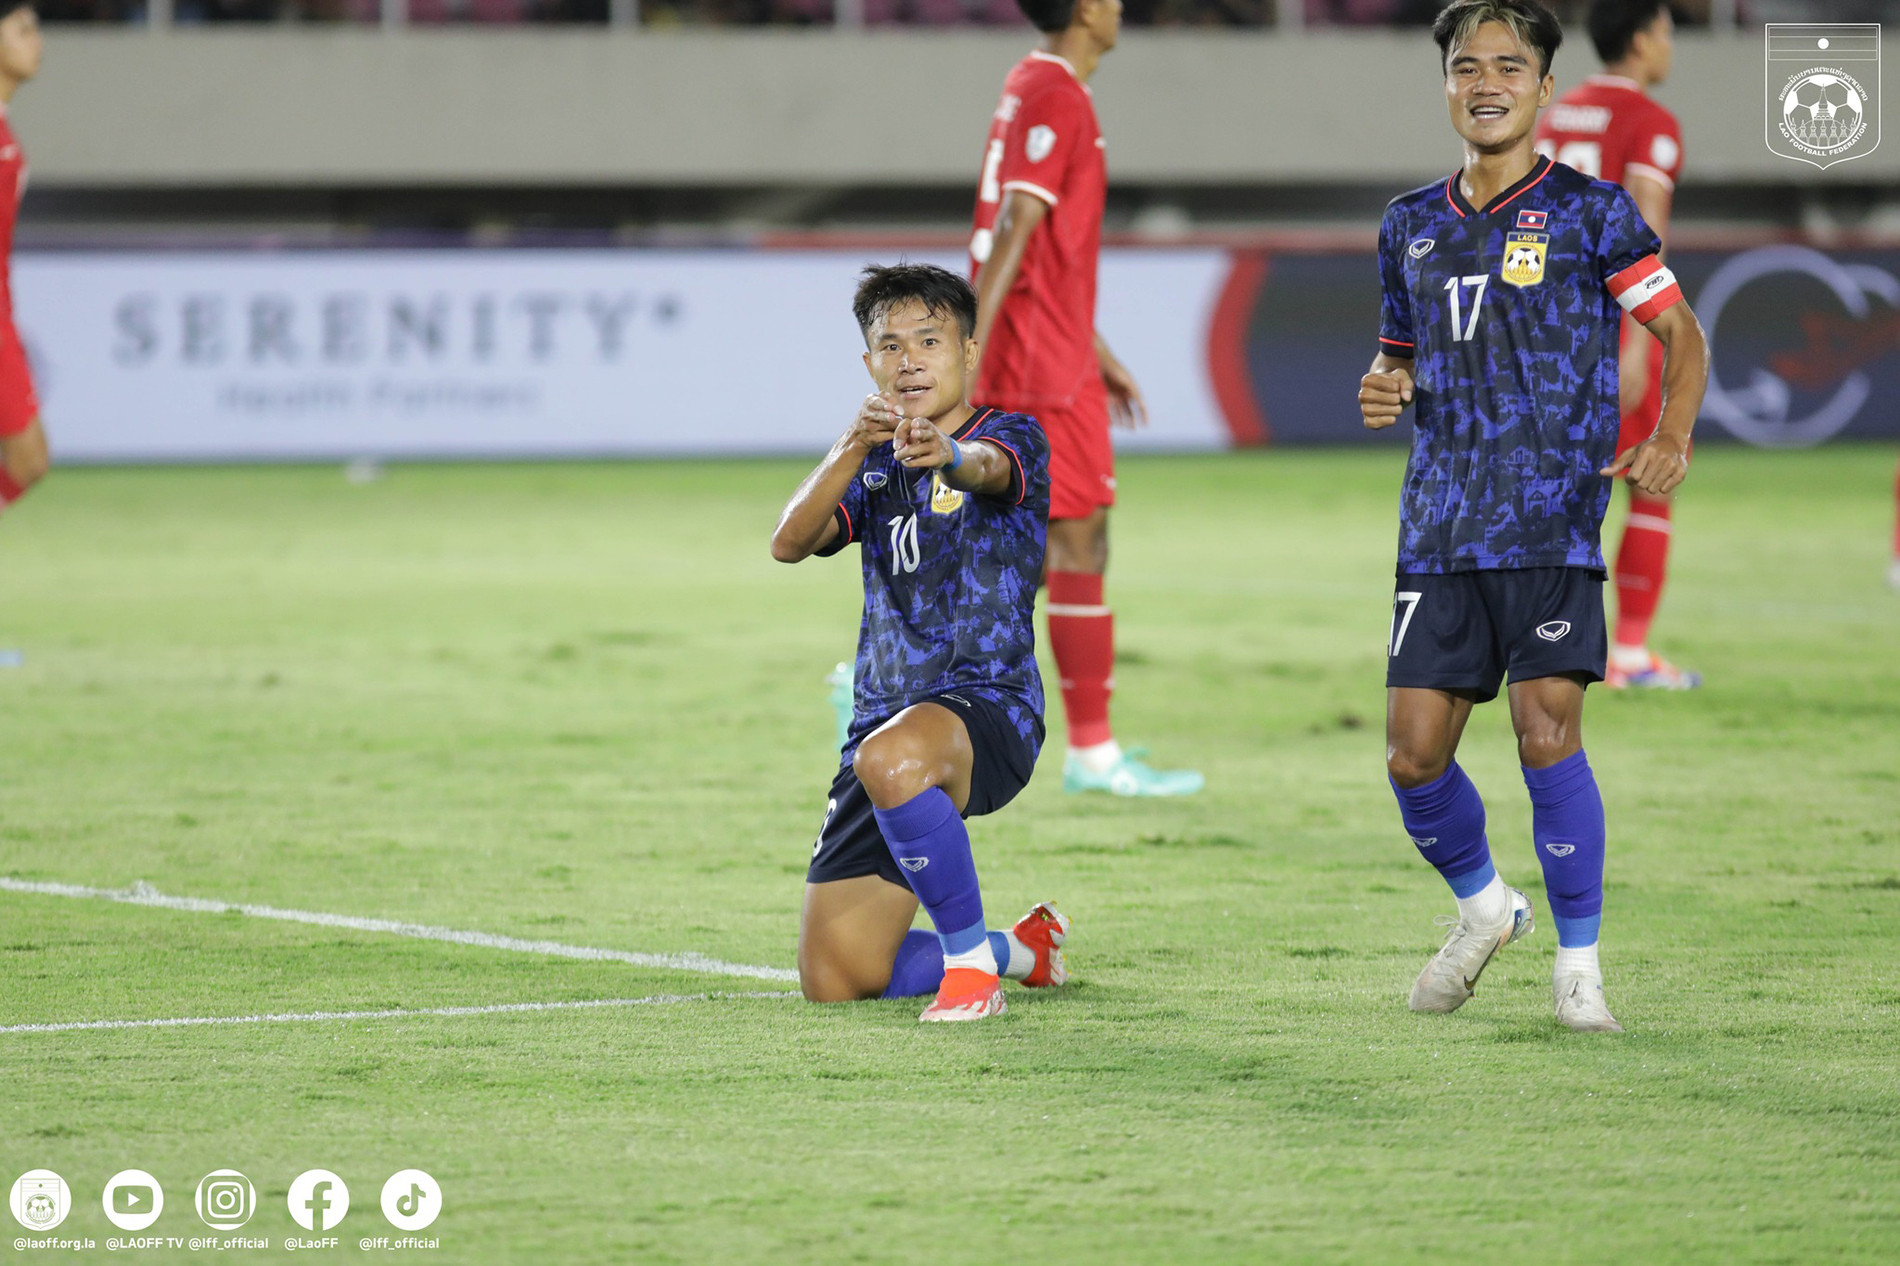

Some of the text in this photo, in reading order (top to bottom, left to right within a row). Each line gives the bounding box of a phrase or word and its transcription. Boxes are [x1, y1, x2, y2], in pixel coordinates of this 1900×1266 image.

[1517, 234, 1538, 242] LAOS
[1444, 274, 1489, 342] 17
[888, 512, 920, 576] 10
